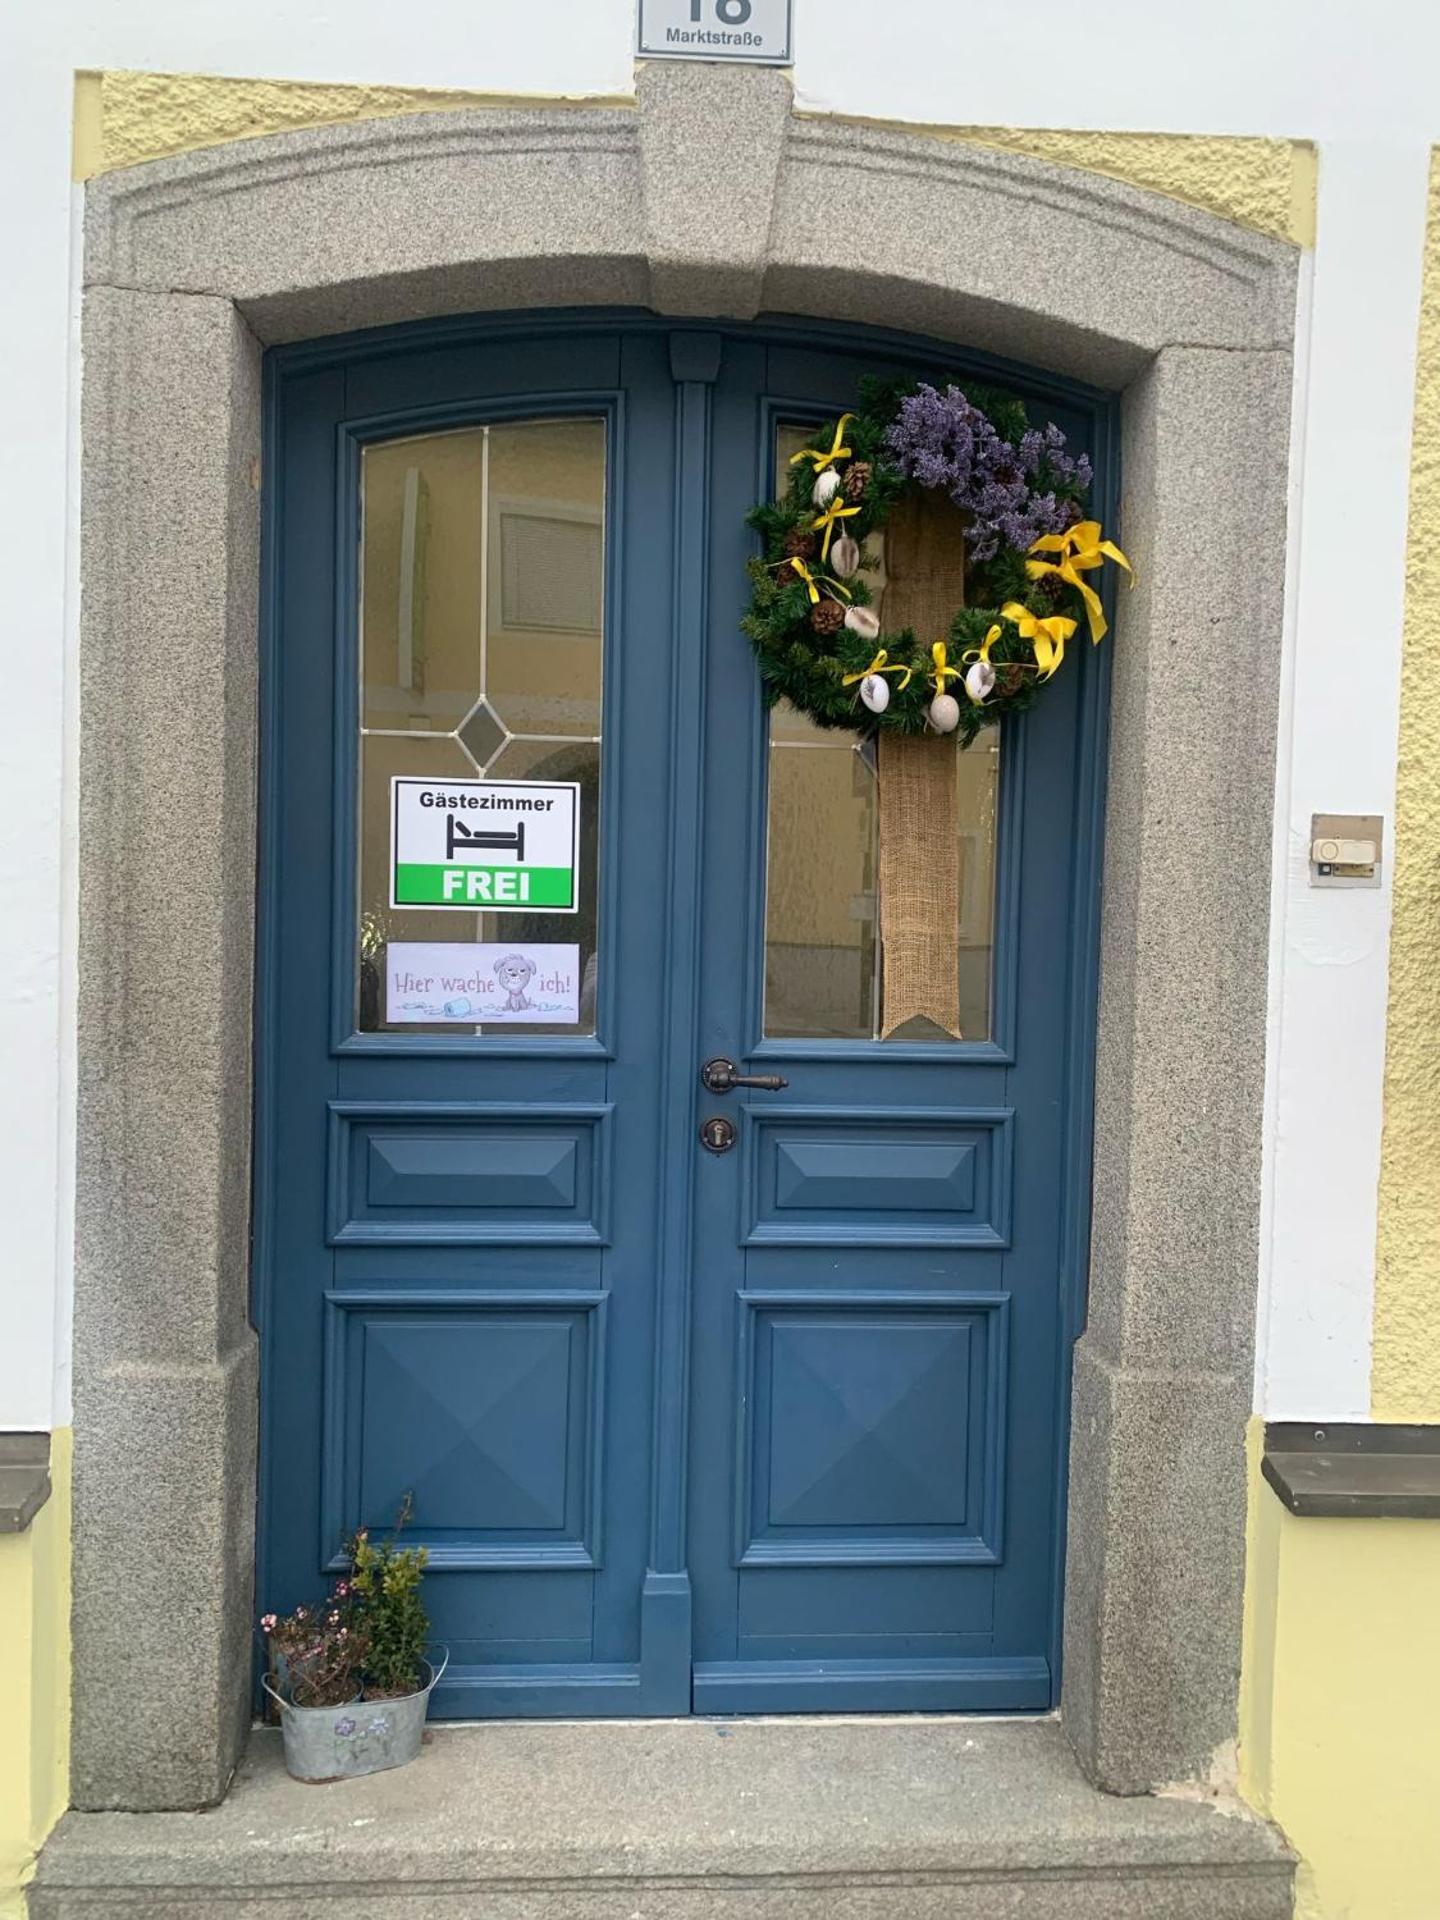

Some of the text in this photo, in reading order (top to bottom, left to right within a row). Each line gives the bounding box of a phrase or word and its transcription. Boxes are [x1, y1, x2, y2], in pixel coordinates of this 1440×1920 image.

[666, 27, 763, 46] Marktstraße
[419, 791, 554, 811] Gästezimmer
[442, 870, 529, 901] FREI
[394, 970, 571, 993] Hier wache ich!
